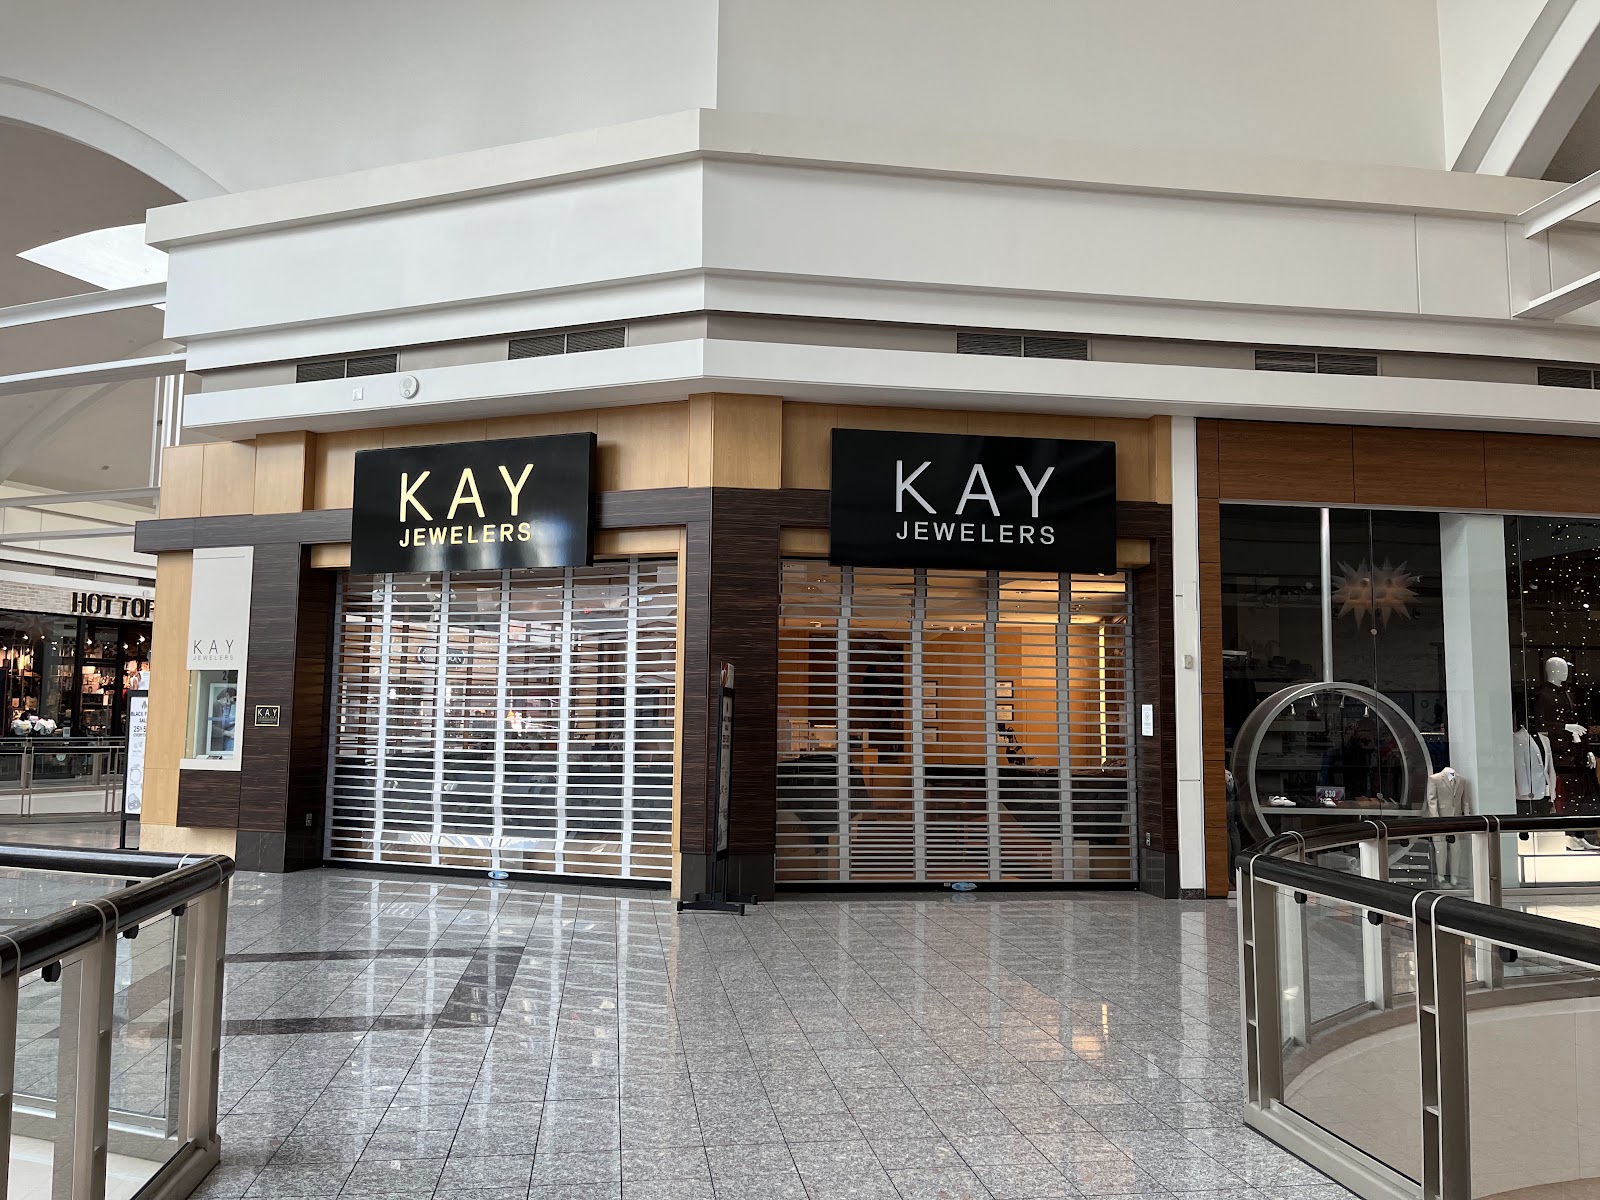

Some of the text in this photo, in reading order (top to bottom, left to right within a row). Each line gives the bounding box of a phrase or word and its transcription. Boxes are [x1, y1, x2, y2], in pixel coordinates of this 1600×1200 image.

[399, 463, 534, 523] KAY
[895, 459, 1056, 518] KAY
[399, 522, 532, 548] JEWELERS
[895, 520, 1055, 545] JEWELERS
[71, 591, 116, 615] HOT
[193, 639, 234, 654] KAY
[257, 708, 278, 717] KAY
